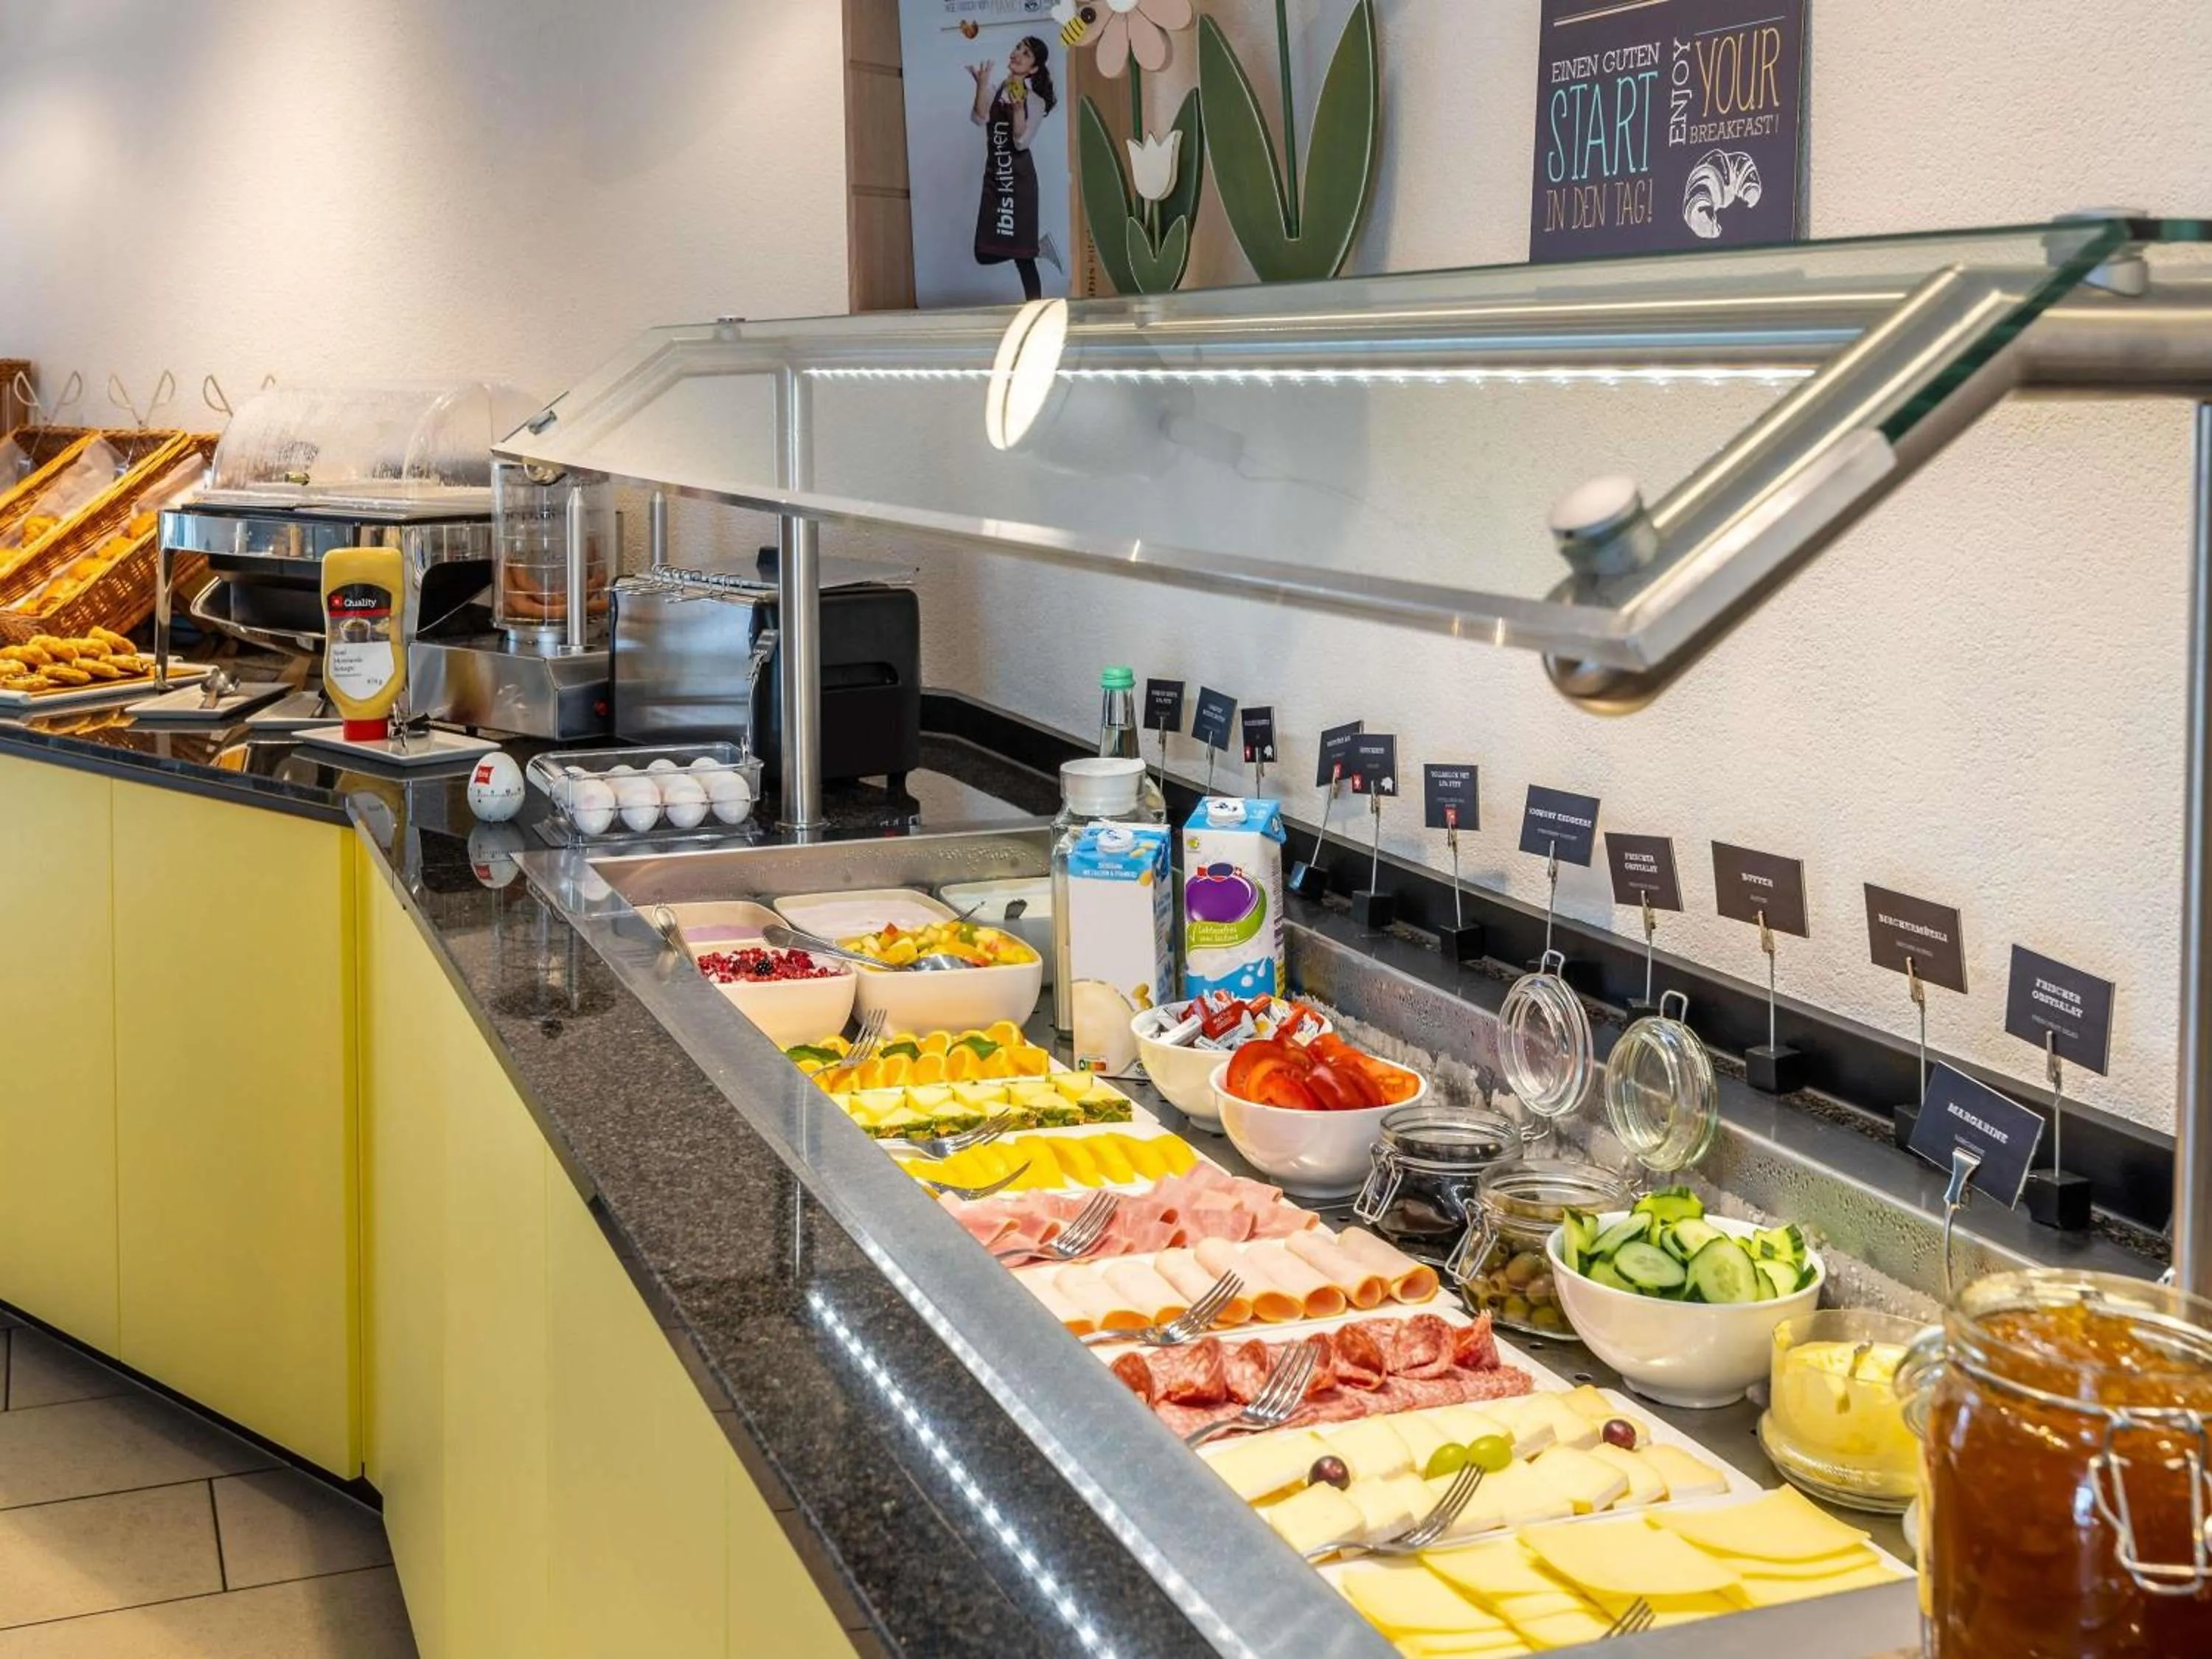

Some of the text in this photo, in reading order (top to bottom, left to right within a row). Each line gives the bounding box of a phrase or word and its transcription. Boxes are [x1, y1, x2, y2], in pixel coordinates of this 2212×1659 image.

[1551, 42, 1660, 83] EINEN GUTEN
[1695, 27, 1780, 117] YOUR
[1669, 38, 1692, 147] ENJOY
[1548, 71, 1658, 183] START
[1690, 114, 1780, 144] BREAKFAST!
[994, 121, 1015, 237] ibis kitchen
[1544, 179, 1653, 232] IN DEN TAG!
[344, 598, 377, 608] Quality
[1741, 872, 1773, 887] BUTTER
[2031, 990, 2083, 1018] OBSTSALAT
[2036, 978, 2081, 1005] FRISCHER
[1947, 1102, 2008, 1144] MARGARINE
